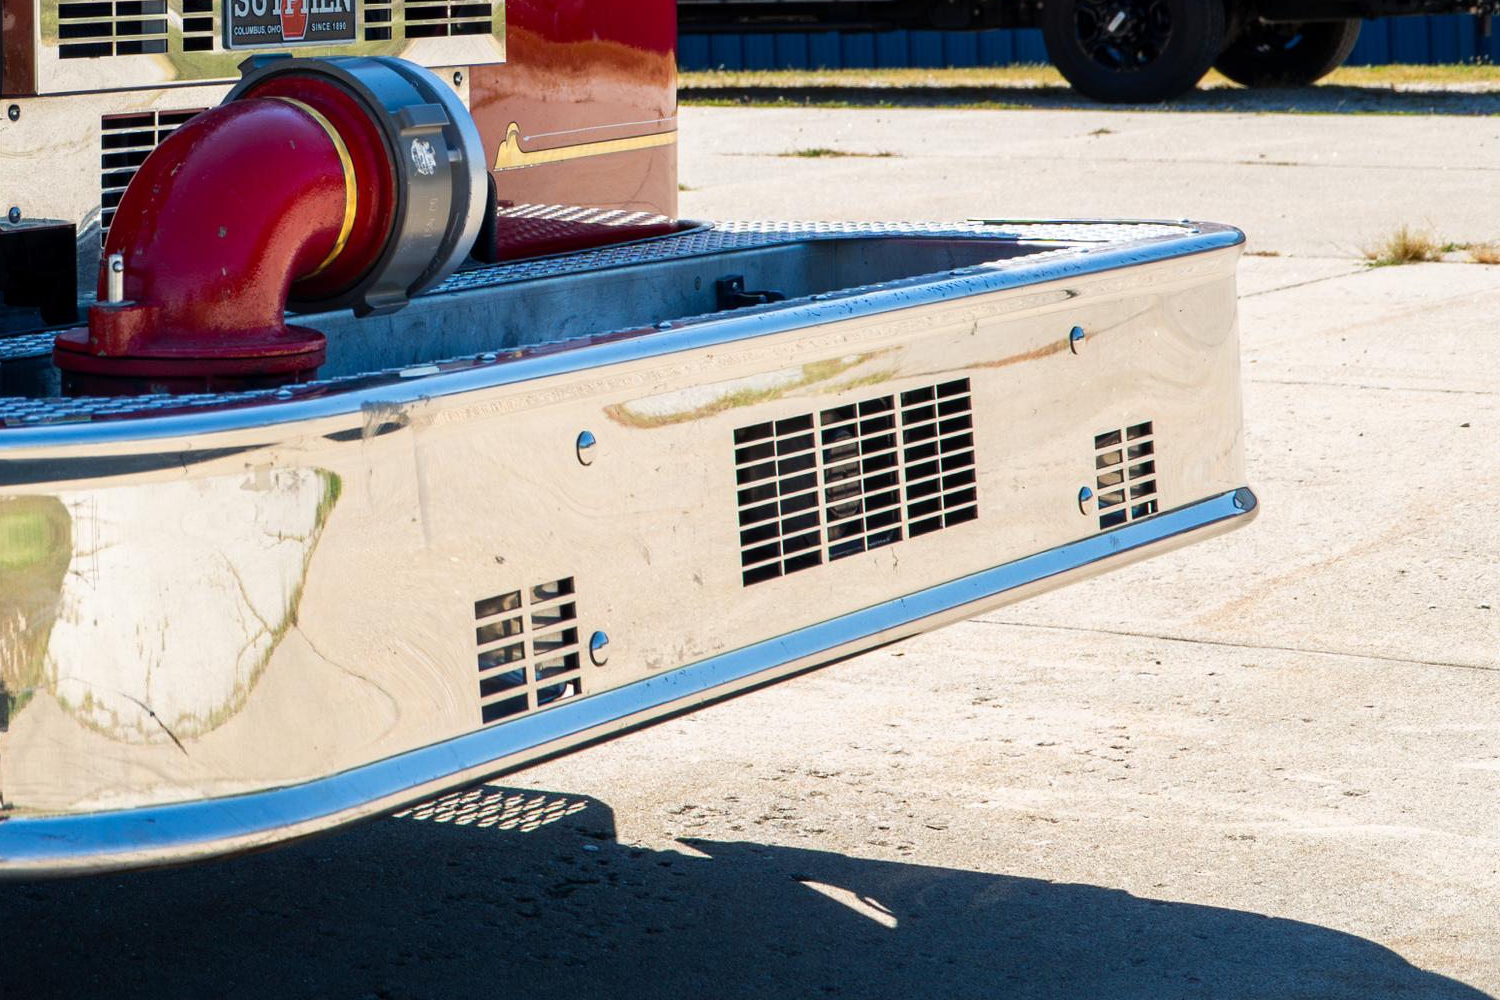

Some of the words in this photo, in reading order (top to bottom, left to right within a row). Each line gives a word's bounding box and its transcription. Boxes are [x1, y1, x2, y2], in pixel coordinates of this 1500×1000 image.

[267, 24, 281, 34] OHIO
[311, 22, 331, 32] SINCE
[332, 21, 347, 31] 1890
